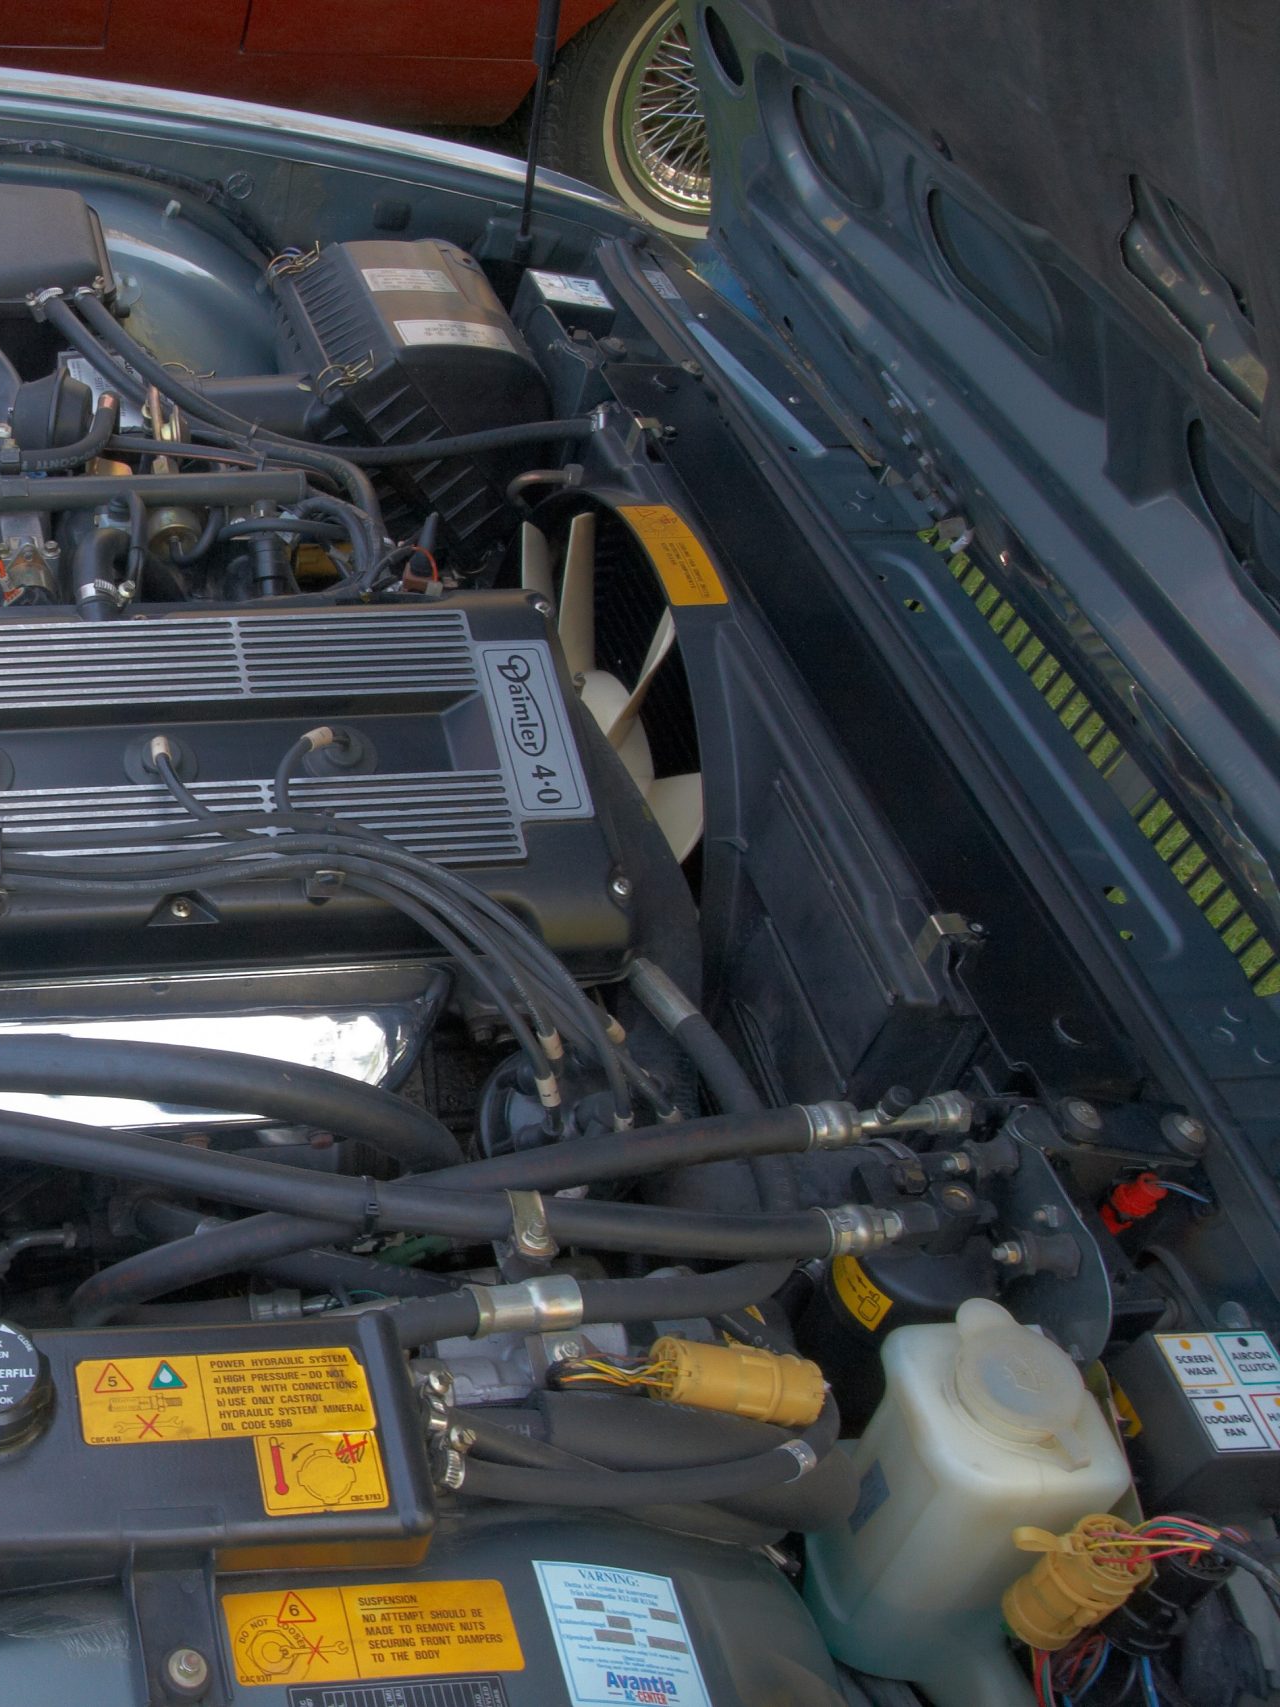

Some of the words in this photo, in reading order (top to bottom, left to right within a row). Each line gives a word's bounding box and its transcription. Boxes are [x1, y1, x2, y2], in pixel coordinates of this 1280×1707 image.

[497, 654, 547, 757] Daimler
[17, 1334, 33, 1352] CLOSE
[210, 1359, 245, 1369] POWER
[251, 1356, 305, 1367] HYDRAULIC
[309, 1354, 348, 1364] SYSTEM
[1175, 1354, 1215, 1364] SCREEN
[1232, 1351, 1272, 1360] AIRCON
[1184, 1367, 1218, 1376] WASH
[1238, 1363, 1278, 1372] CLUTCH
[108, 1376, 118, 1387] 5
[213, 1376, 222, 1384] a)
[223, 1374, 246, 1383] HIGH
[326, 1370, 346, 1379] NOT
[216, 1386, 255, 1396] TAMPER
[261, 1384, 288, 1392] WITH
[292, 1380, 358, 1392] CONNECTIONS
[216, 1399, 226, 1408] b)
[228, 1397, 246, 1406] USE
[252, 1396, 275, 1405] ONLY
[280, 1394, 324, 1404] CASTROL
[218, 1408, 274, 1419] HYDRAULIC
[278, 1406, 318, 1416] SYSTEM
[323, 1404, 366, 1414] MINERAL
[221, 1422, 236, 1432] OIL
[241, 1420, 267, 1430] CODE
[269, 1418, 293, 1428] 5966
[1204, 1414, 1252, 1425] COOLING
[1224, 1428, 1248, 1437] FAN
[578, 1568, 640, 1588] VARNING:
[358, 1594, 418, 1606] SUSPENSION
[288, 1604, 300, 1616] 6
[362, 1614, 377, 1623] NO
[380, 1610, 424, 1622] ATTEMPT
[430, 1609, 466, 1620] SHOULD
[472, 1608, 484, 1618] BE
[238, 1630, 250, 1644] DO
[250, 1618, 269, 1630] NOT
[365, 1626, 394, 1636] MADE
[400, 1625, 413, 1634] TO
[416, 1622, 456, 1633] REMOVE
[460, 1622, 486, 1631] NUTS
[368, 1638, 416, 1650] SECURING
[420, 1636, 452, 1647] FRONT
[458, 1634, 504, 1645] DAMPERS
[372, 1653, 385, 1663] TO
[390, 1652, 410, 1662] THE
[416, 1650, 440, 1660] BODY
[606, 1671, 678, 1695] Avantia
